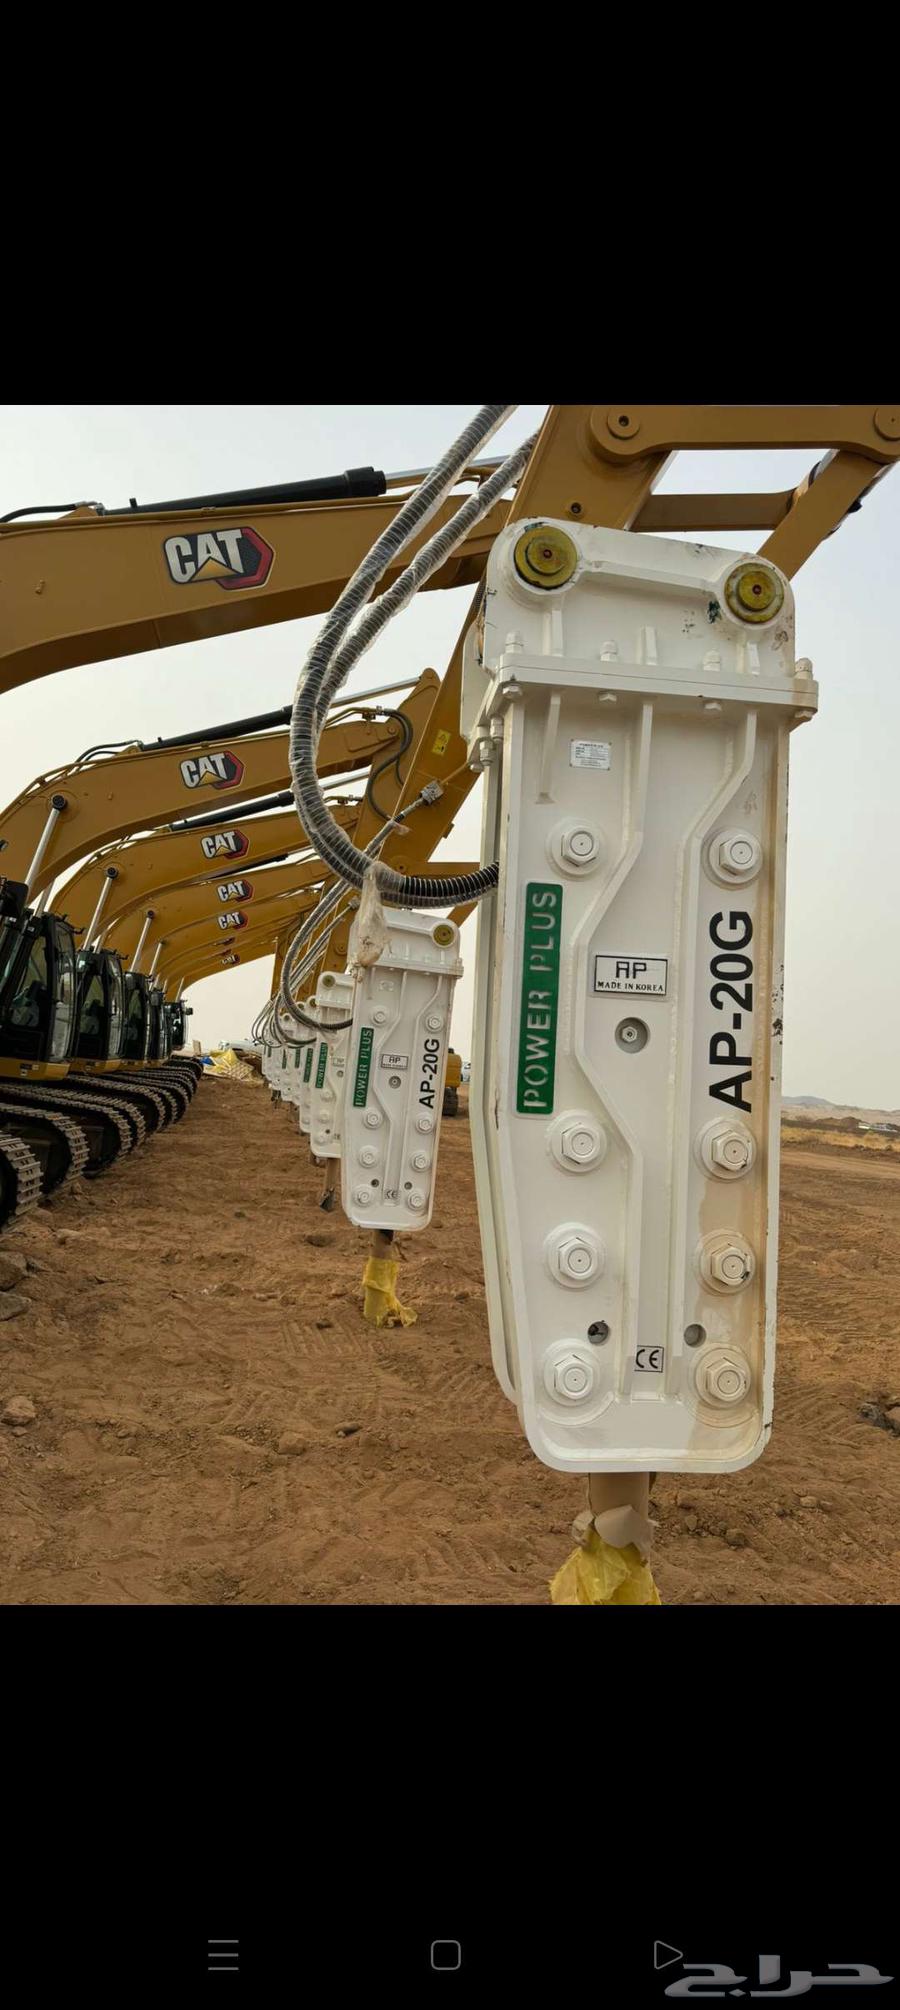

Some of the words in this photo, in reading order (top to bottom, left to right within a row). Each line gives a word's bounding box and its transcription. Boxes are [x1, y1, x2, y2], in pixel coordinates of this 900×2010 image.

[165, 528, 244, 583] CAT
[181, 752, 228, 788] CAT
[201, 831, 237, 858] CAT
[217, 881, 244, 902] CAT
[218, 911, 241, 929] CAT
[530, 891, 556, 971] PLUS
[597, 981, 621, 989] MADE
[616, 961, 646, 979] AP
[709, 910, 753, 1113] AP-20G
[360, 1030, 373, 1058] PLUS
[523, 990, 551, 1107] POWER
[355, 1064, 368, 1106] POWER
[419, 1038, 439, 1109] AP-20G
[636, 1349, 659, 1369] CE
